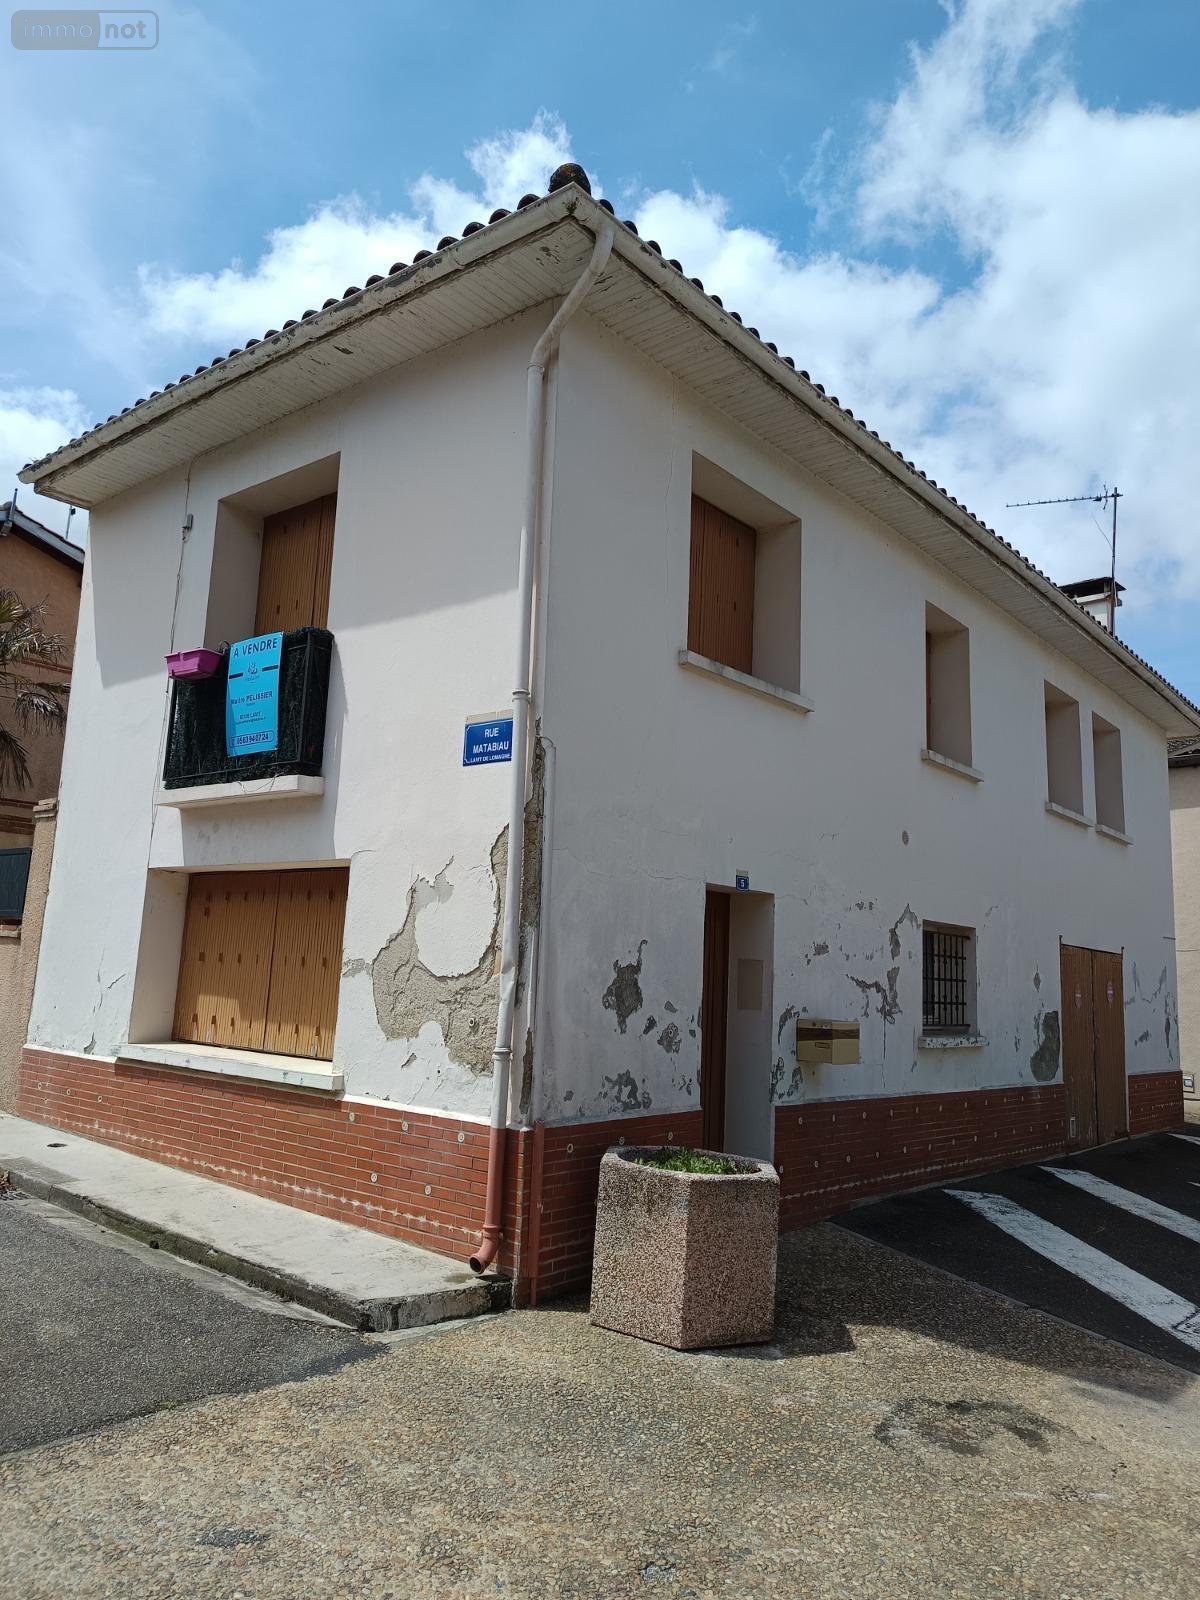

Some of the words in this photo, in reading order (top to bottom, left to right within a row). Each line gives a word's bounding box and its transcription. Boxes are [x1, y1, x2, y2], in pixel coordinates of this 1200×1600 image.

[233, 647, 239, 657] A
[242, 638, 277, 655] VENDRE
[246, 690, 273, 702] PELISSIER
[484, 727, 499, 738] RUE
[472, 741, 509, 754] MATABIAU
[740, 879, 745, 888] 5
